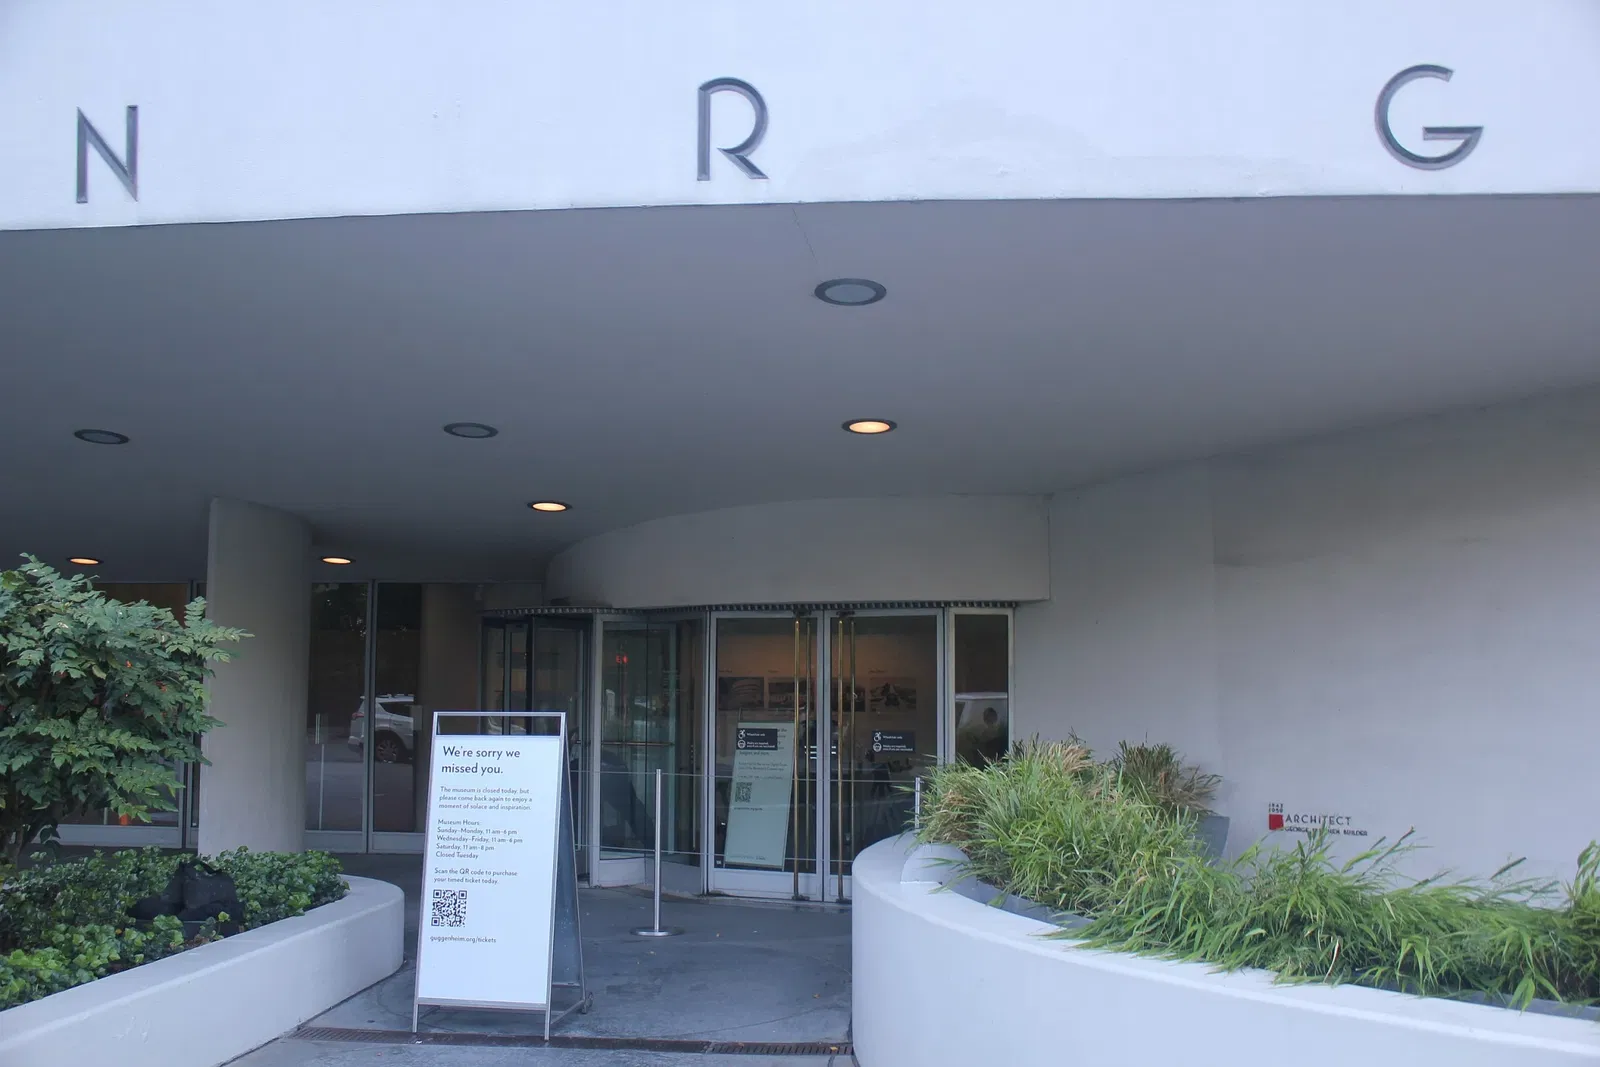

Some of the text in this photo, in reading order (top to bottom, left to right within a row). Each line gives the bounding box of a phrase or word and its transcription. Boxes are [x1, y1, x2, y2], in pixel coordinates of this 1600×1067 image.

[76, 64, 1483, 203] N R G
[442, 746, 520, 760] We're sorry we
[441, 762, 504, 776] missed you.
[1285, 814, 1352, 826] ARCHITECT
[430, 936, 496, 944] guggenheim.org/tickets
